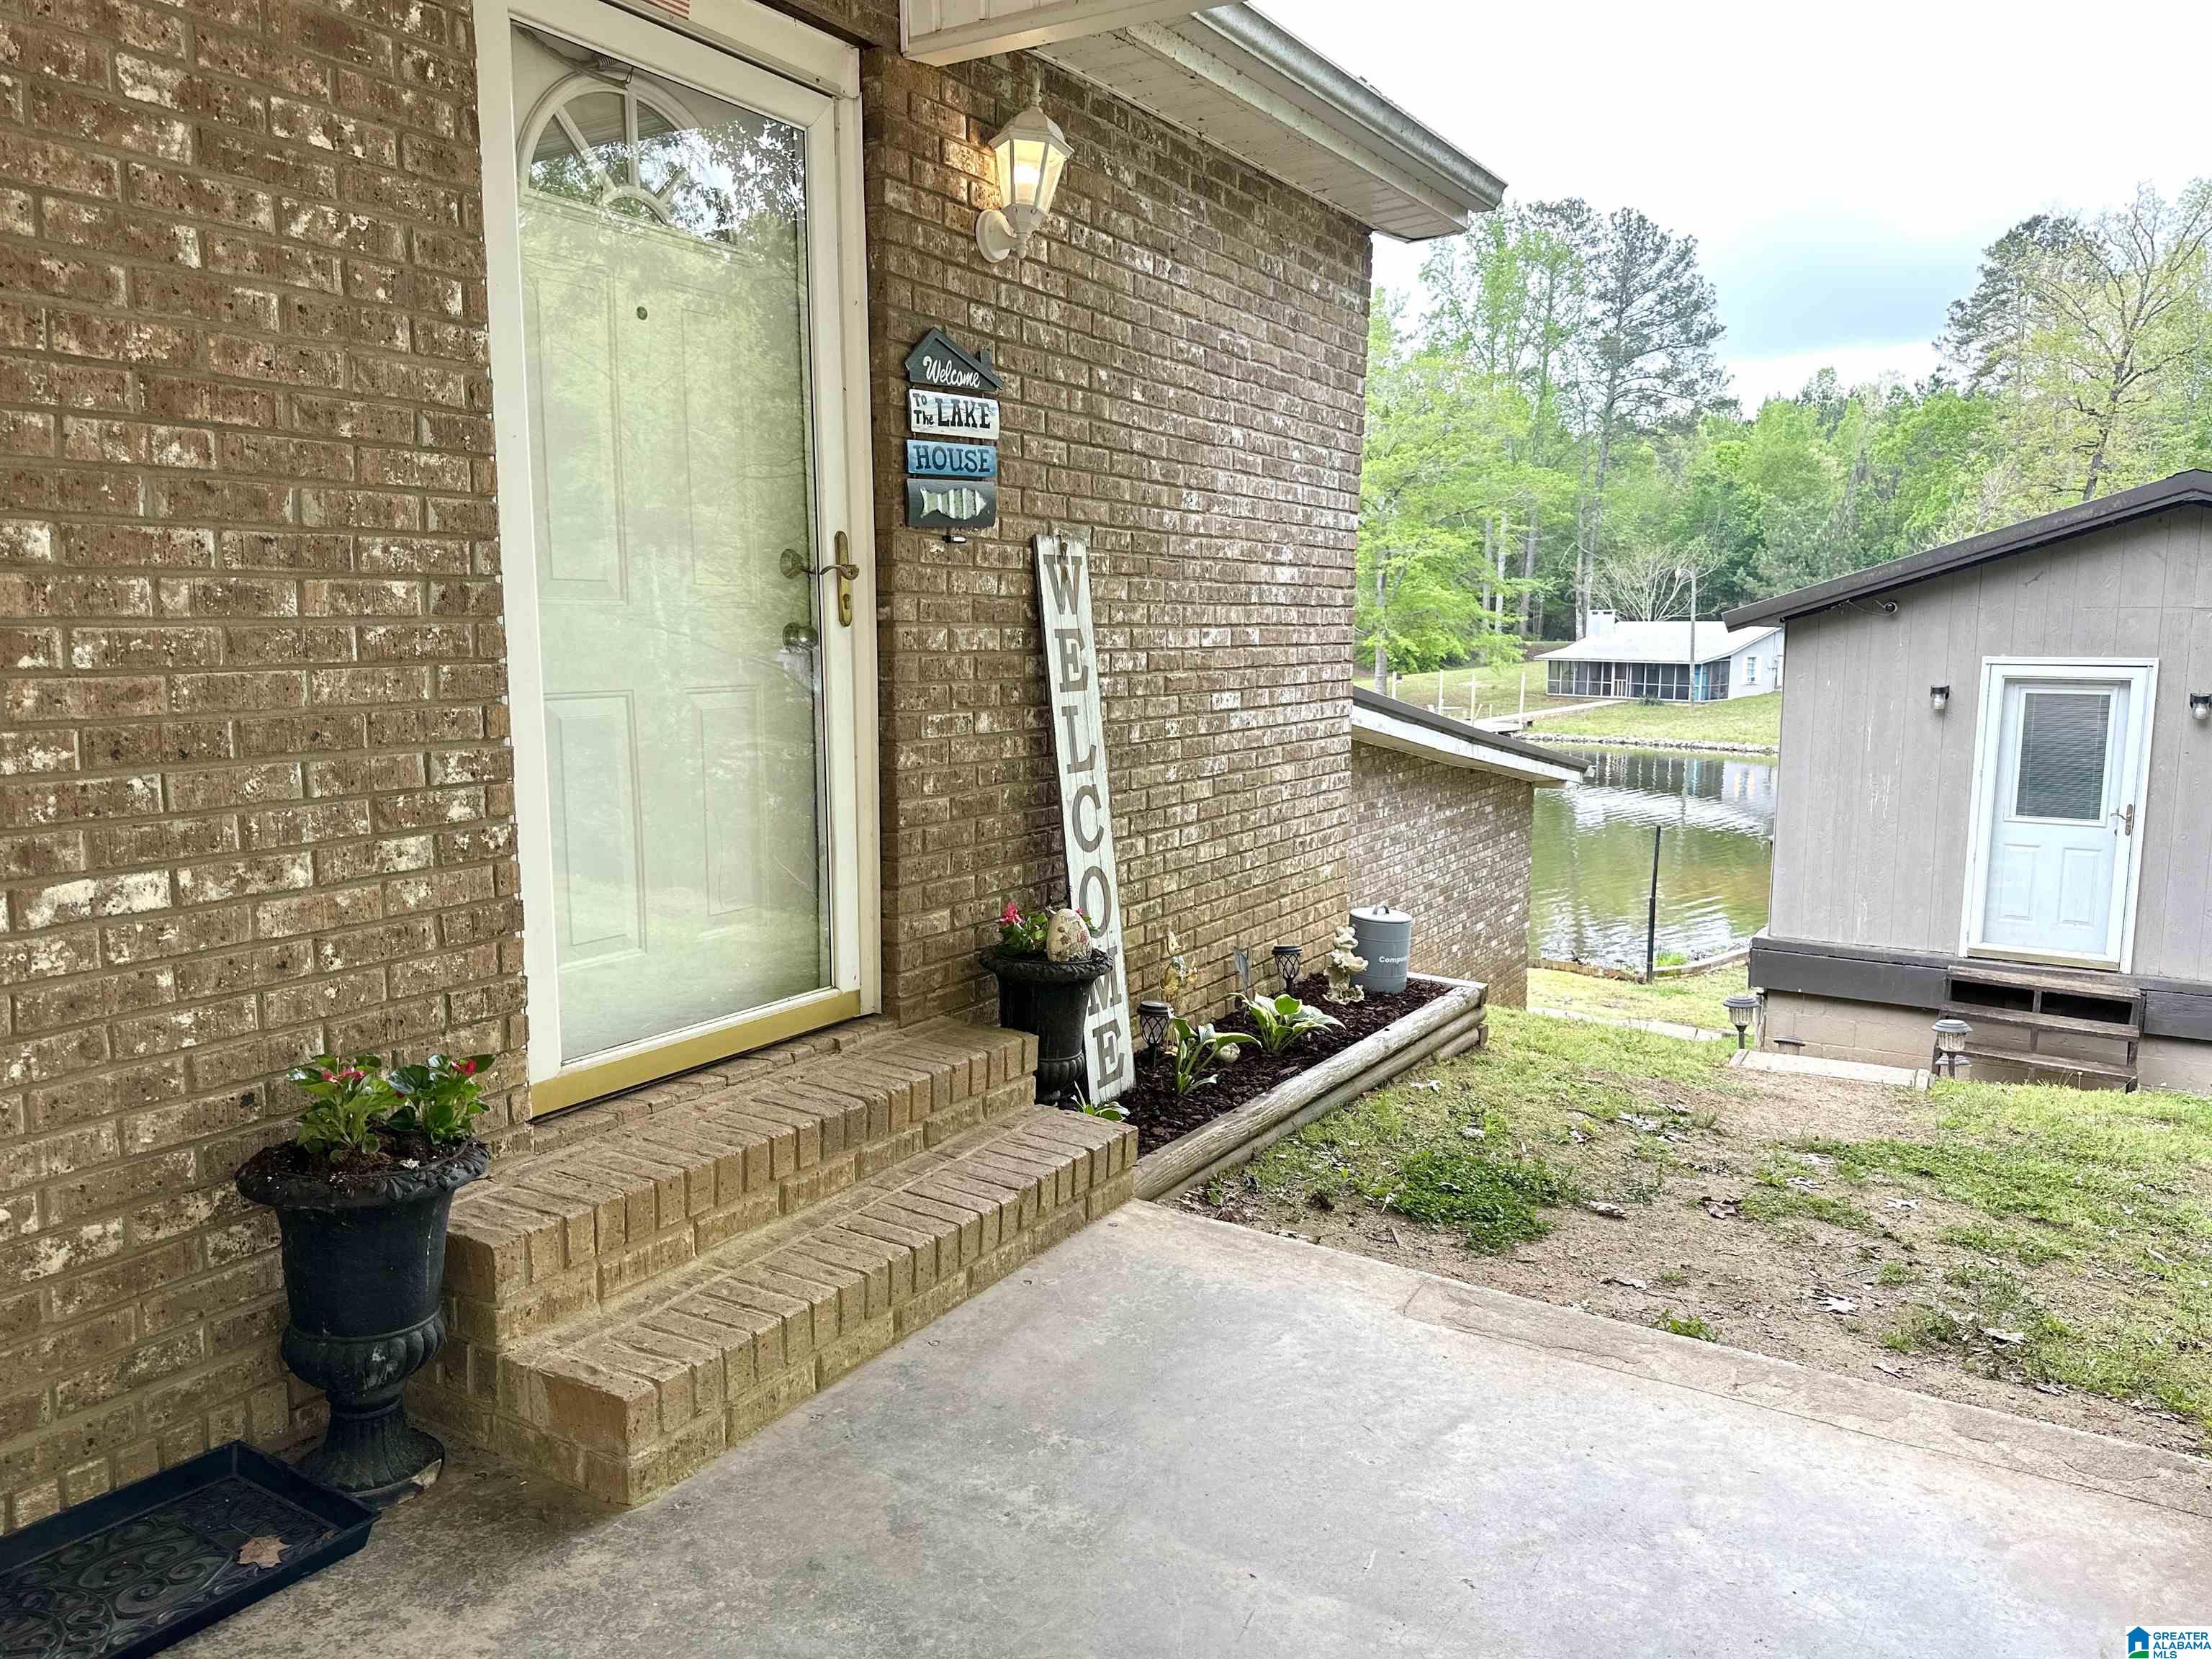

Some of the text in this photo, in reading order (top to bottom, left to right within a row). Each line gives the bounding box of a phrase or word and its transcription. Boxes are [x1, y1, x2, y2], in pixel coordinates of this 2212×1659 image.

[922, 356, 980, 388] Welcome
[914, 397, 991, 429] The LAKE
[913, 445, 990, 473] HOUSE
[1043, 554, 1124, 1089] WELCOME
